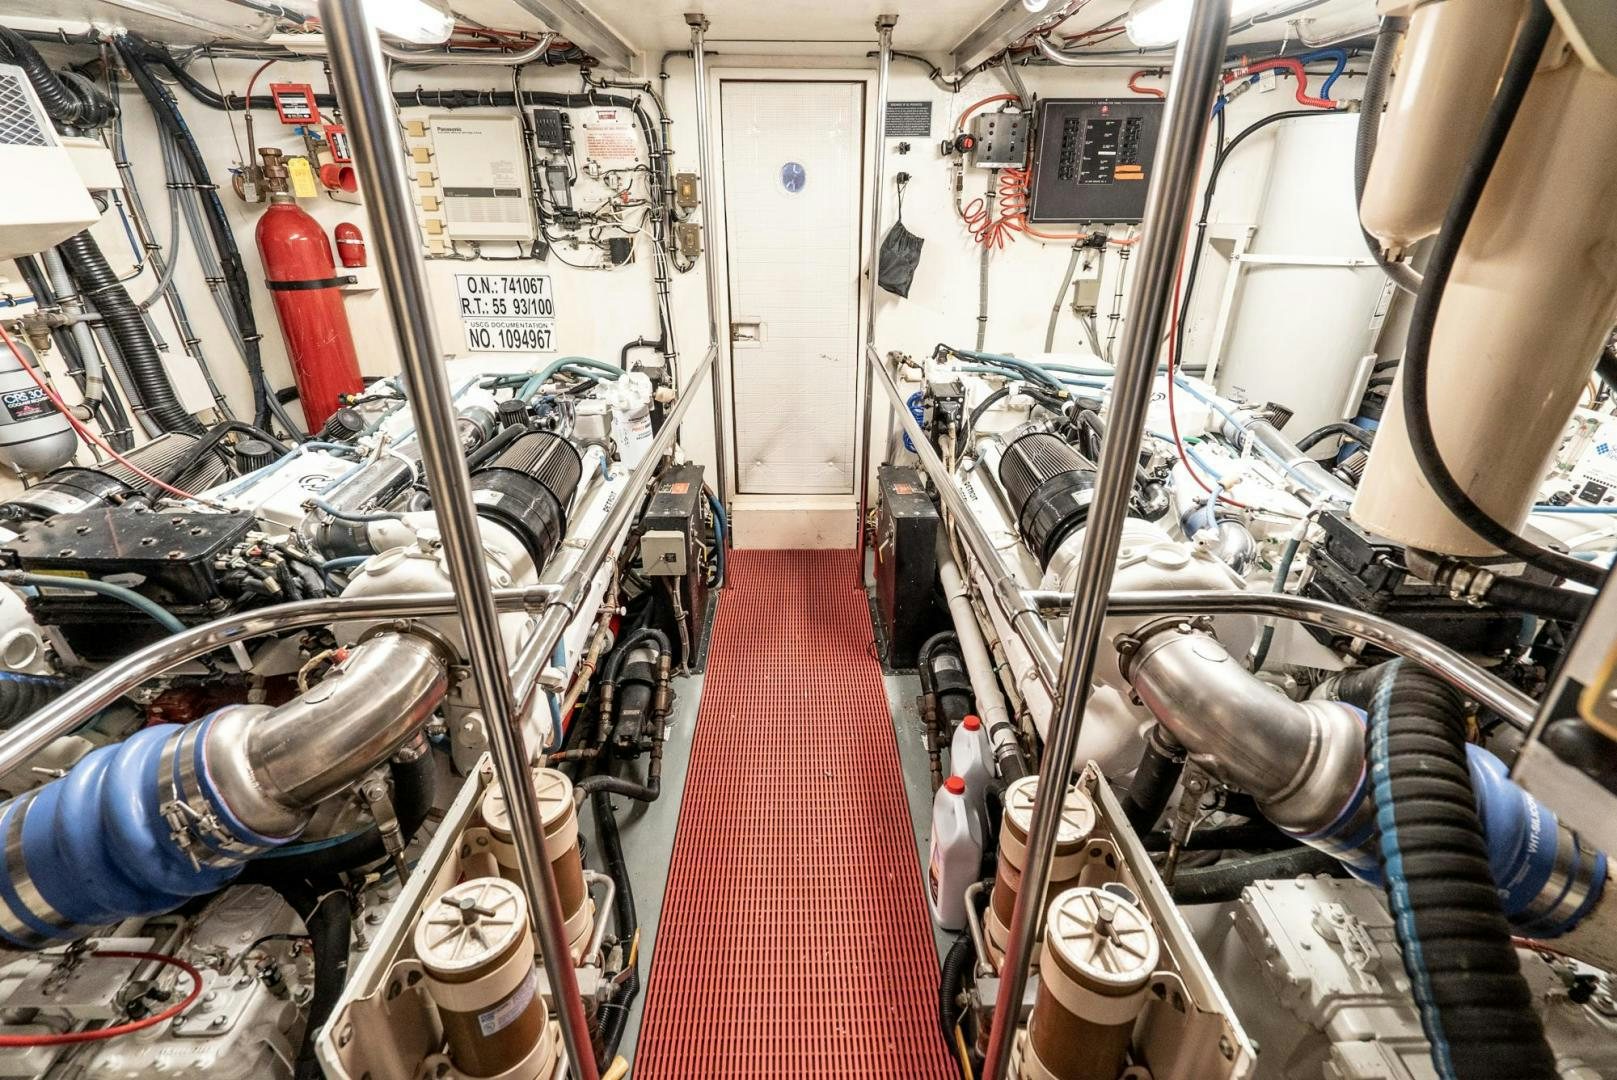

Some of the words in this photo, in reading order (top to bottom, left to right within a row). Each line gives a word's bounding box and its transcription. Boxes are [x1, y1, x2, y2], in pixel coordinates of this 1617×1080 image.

[467, 277, 498, 294] O.N.:
[501, 277, 544, 294] 741067
[461, 298, 489, 314] R.T.:
[492, 298, 507, 315] 55
[513, 298, 553, 315] 93/100
[469, 328, 495, 348] NO.
[498, 328, 551, 349] 1094967
[4, 392, 29, 404] CRS
[1526, 793, 1541, 853] VHT-SILICON
